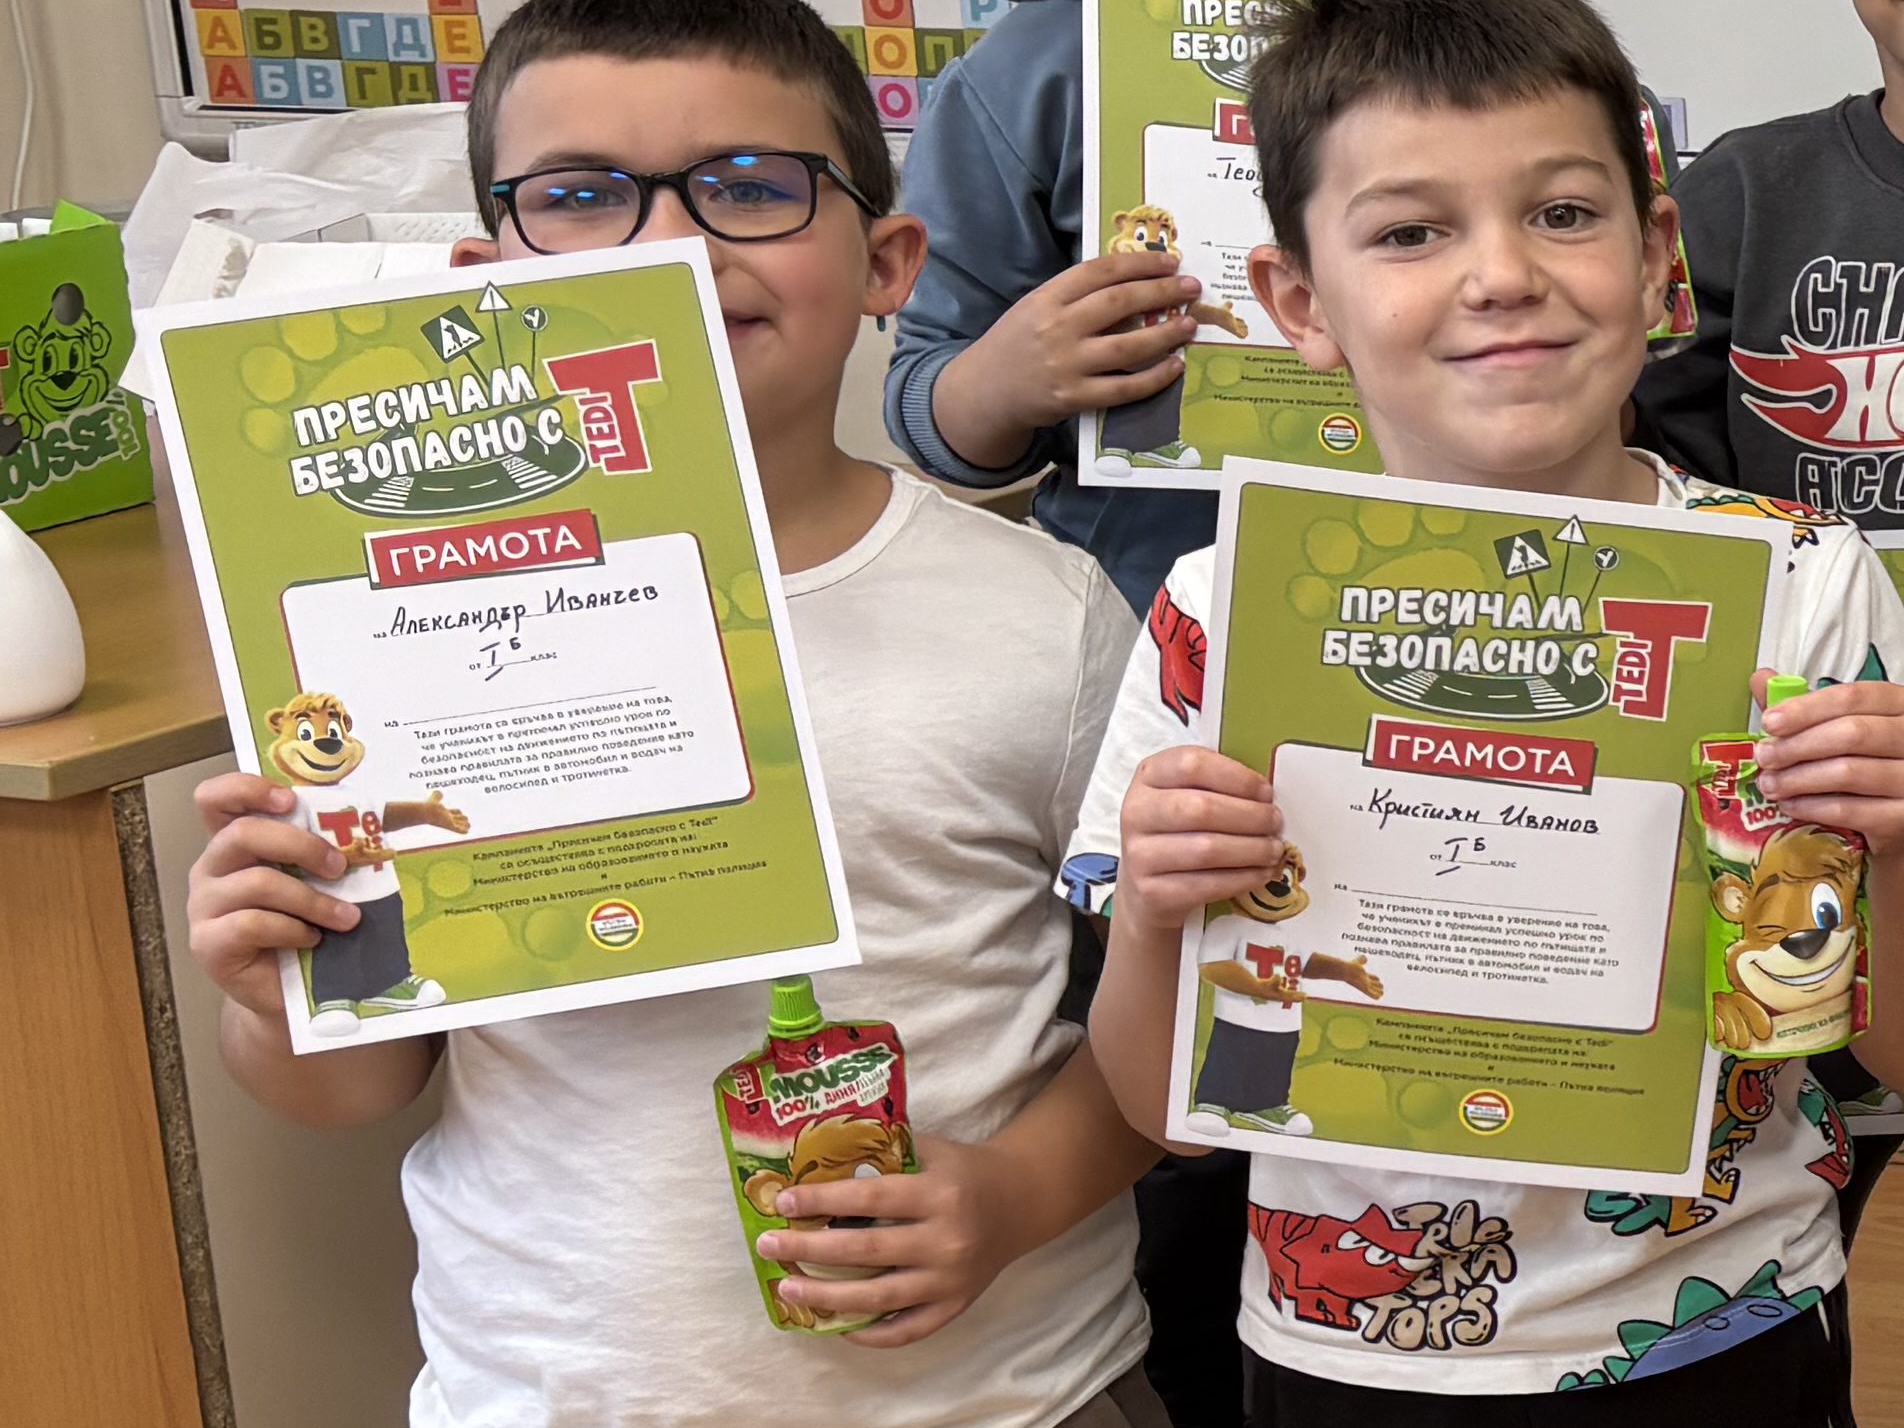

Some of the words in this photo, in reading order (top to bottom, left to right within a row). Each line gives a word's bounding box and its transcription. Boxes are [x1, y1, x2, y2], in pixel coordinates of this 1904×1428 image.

[0, 407, 120, 503] OUSSE
[388, 524, 582, 576] ГРАМОТА
[1369, 788, 1481, 830] Кристиян
[1500, 805, 1599, 834] Иванов
[772, 1047, 895, 1105] MOUSSE
